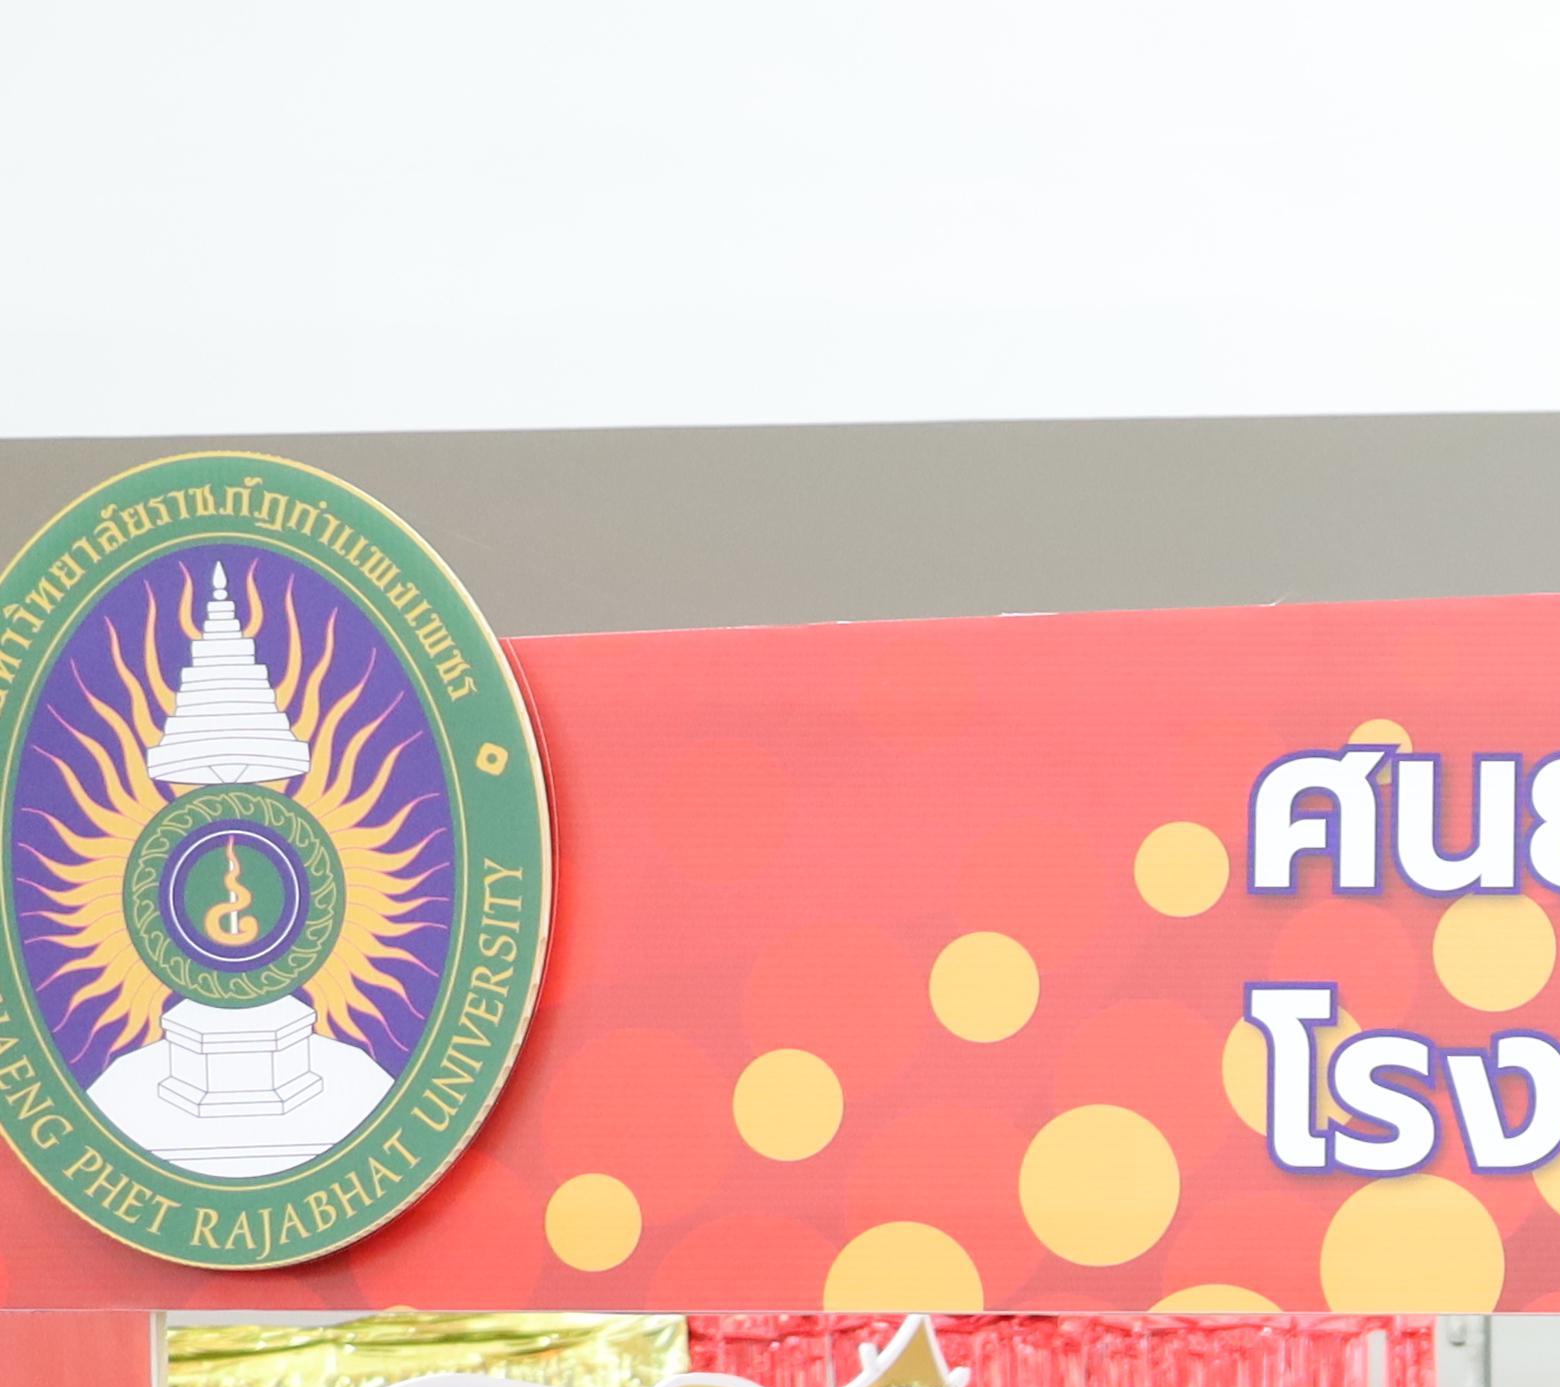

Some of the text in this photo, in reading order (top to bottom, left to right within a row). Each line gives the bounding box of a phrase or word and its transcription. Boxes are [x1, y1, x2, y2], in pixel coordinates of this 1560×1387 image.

[63, 1145, 182, 1236] PHET
[190, 1128, 422, 1261] RAJABHAT
[410, 857, 524, 1134] UNIVERSITY
